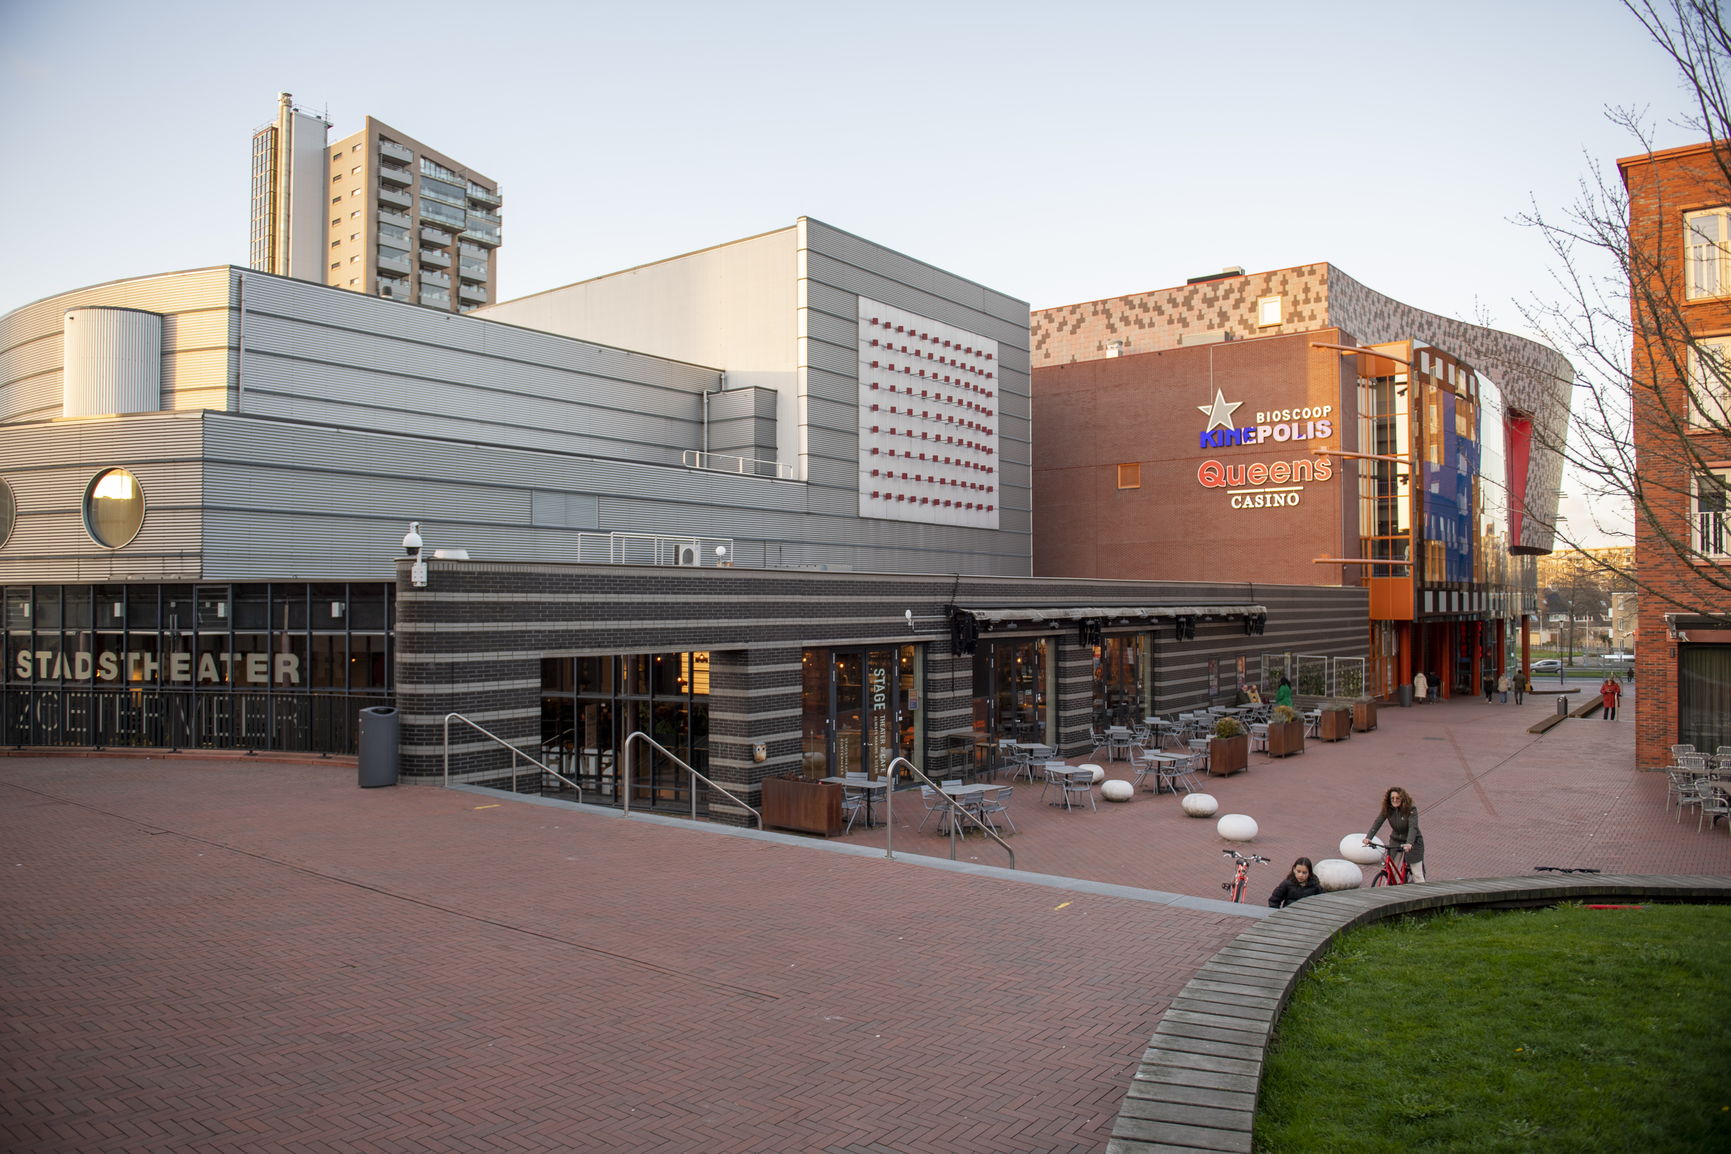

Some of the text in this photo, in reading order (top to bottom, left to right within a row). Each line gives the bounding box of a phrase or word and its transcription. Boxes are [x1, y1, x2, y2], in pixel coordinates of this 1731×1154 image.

[1256, 405, 1332, 424] BIOSCOOP
[1199, 419, 1333, 449] KINEPOLIS
[1197, 457, 1333, 488] Queens
[1231, 492, 1300, 509] CASINO
[15, 649, 300, 684] STADSTHEATER
[873, 668, 886, 711] STAGE
